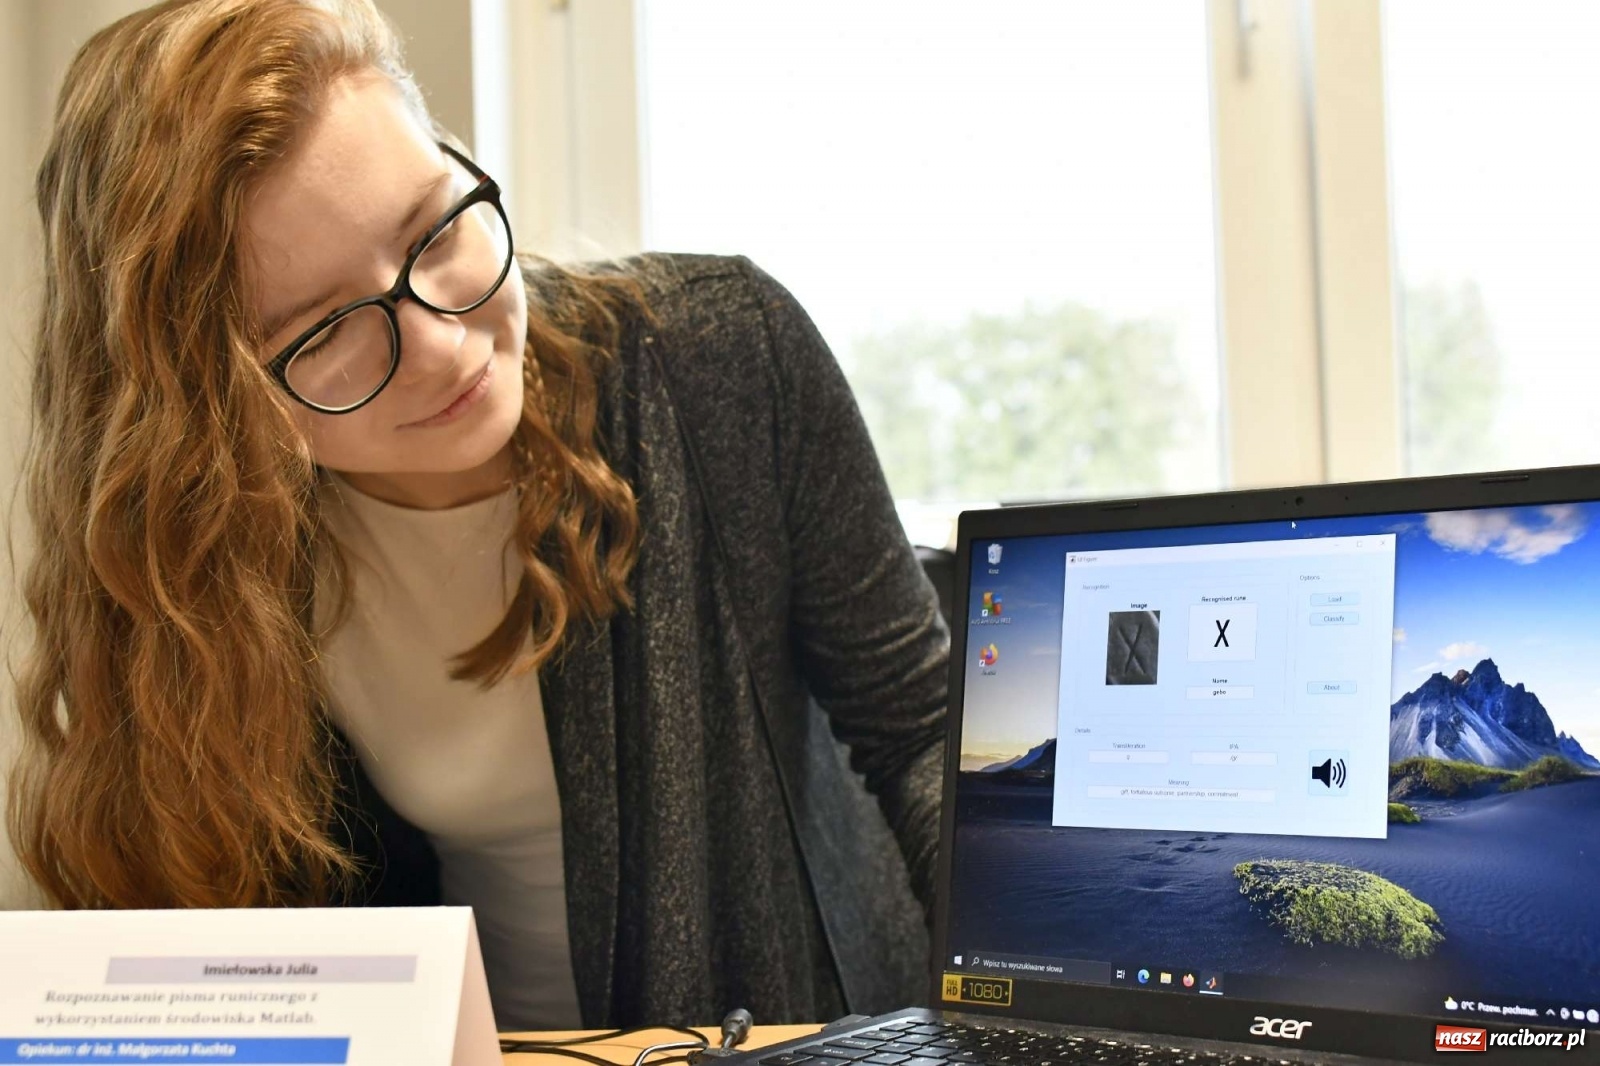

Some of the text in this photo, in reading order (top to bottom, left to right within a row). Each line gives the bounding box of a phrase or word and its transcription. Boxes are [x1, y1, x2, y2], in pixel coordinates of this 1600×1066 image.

[1323, 615, 1345, 623] Classify
[286, 963, 319, 975] Julia
[983, 959, 1000, 970] Wpisz
[1008, 962, 1045, 972] wyszukiwane
[1046, 964, 1063, 973] słowa
[45, 990, 319, 1005] Rozpoznawanie pisma runicznego z
[946, 986, 958, 996] HD
[969, 982, 1003, 999] 1080
[1460, 1000, 1475, 1011] 0°C
[35, 1013, 162, 1027] wykorzystaniem
[1250, 1016, 1312, 1039] acer
[76, 1042, 92, 1057] dr
